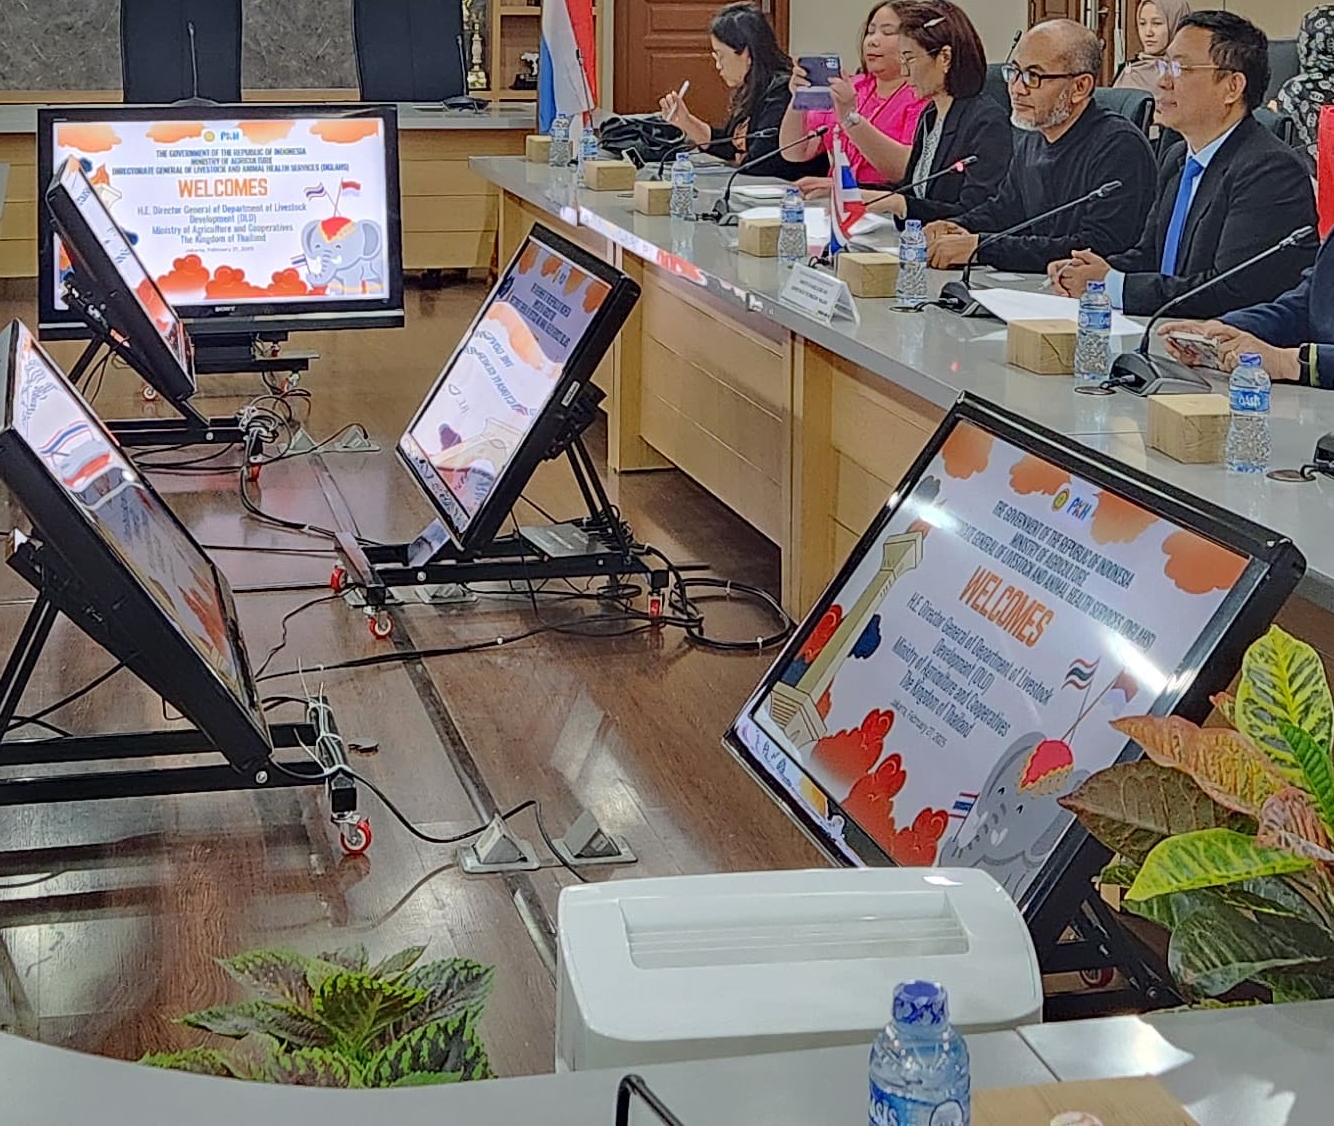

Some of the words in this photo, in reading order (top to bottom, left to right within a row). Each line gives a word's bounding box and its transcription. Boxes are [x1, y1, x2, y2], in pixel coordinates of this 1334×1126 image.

[177, 177, 268, 198] WELCOMES
[1066, 495, 1094, 521] PKH
[956, 565, 1055, 648] WELCOMES
